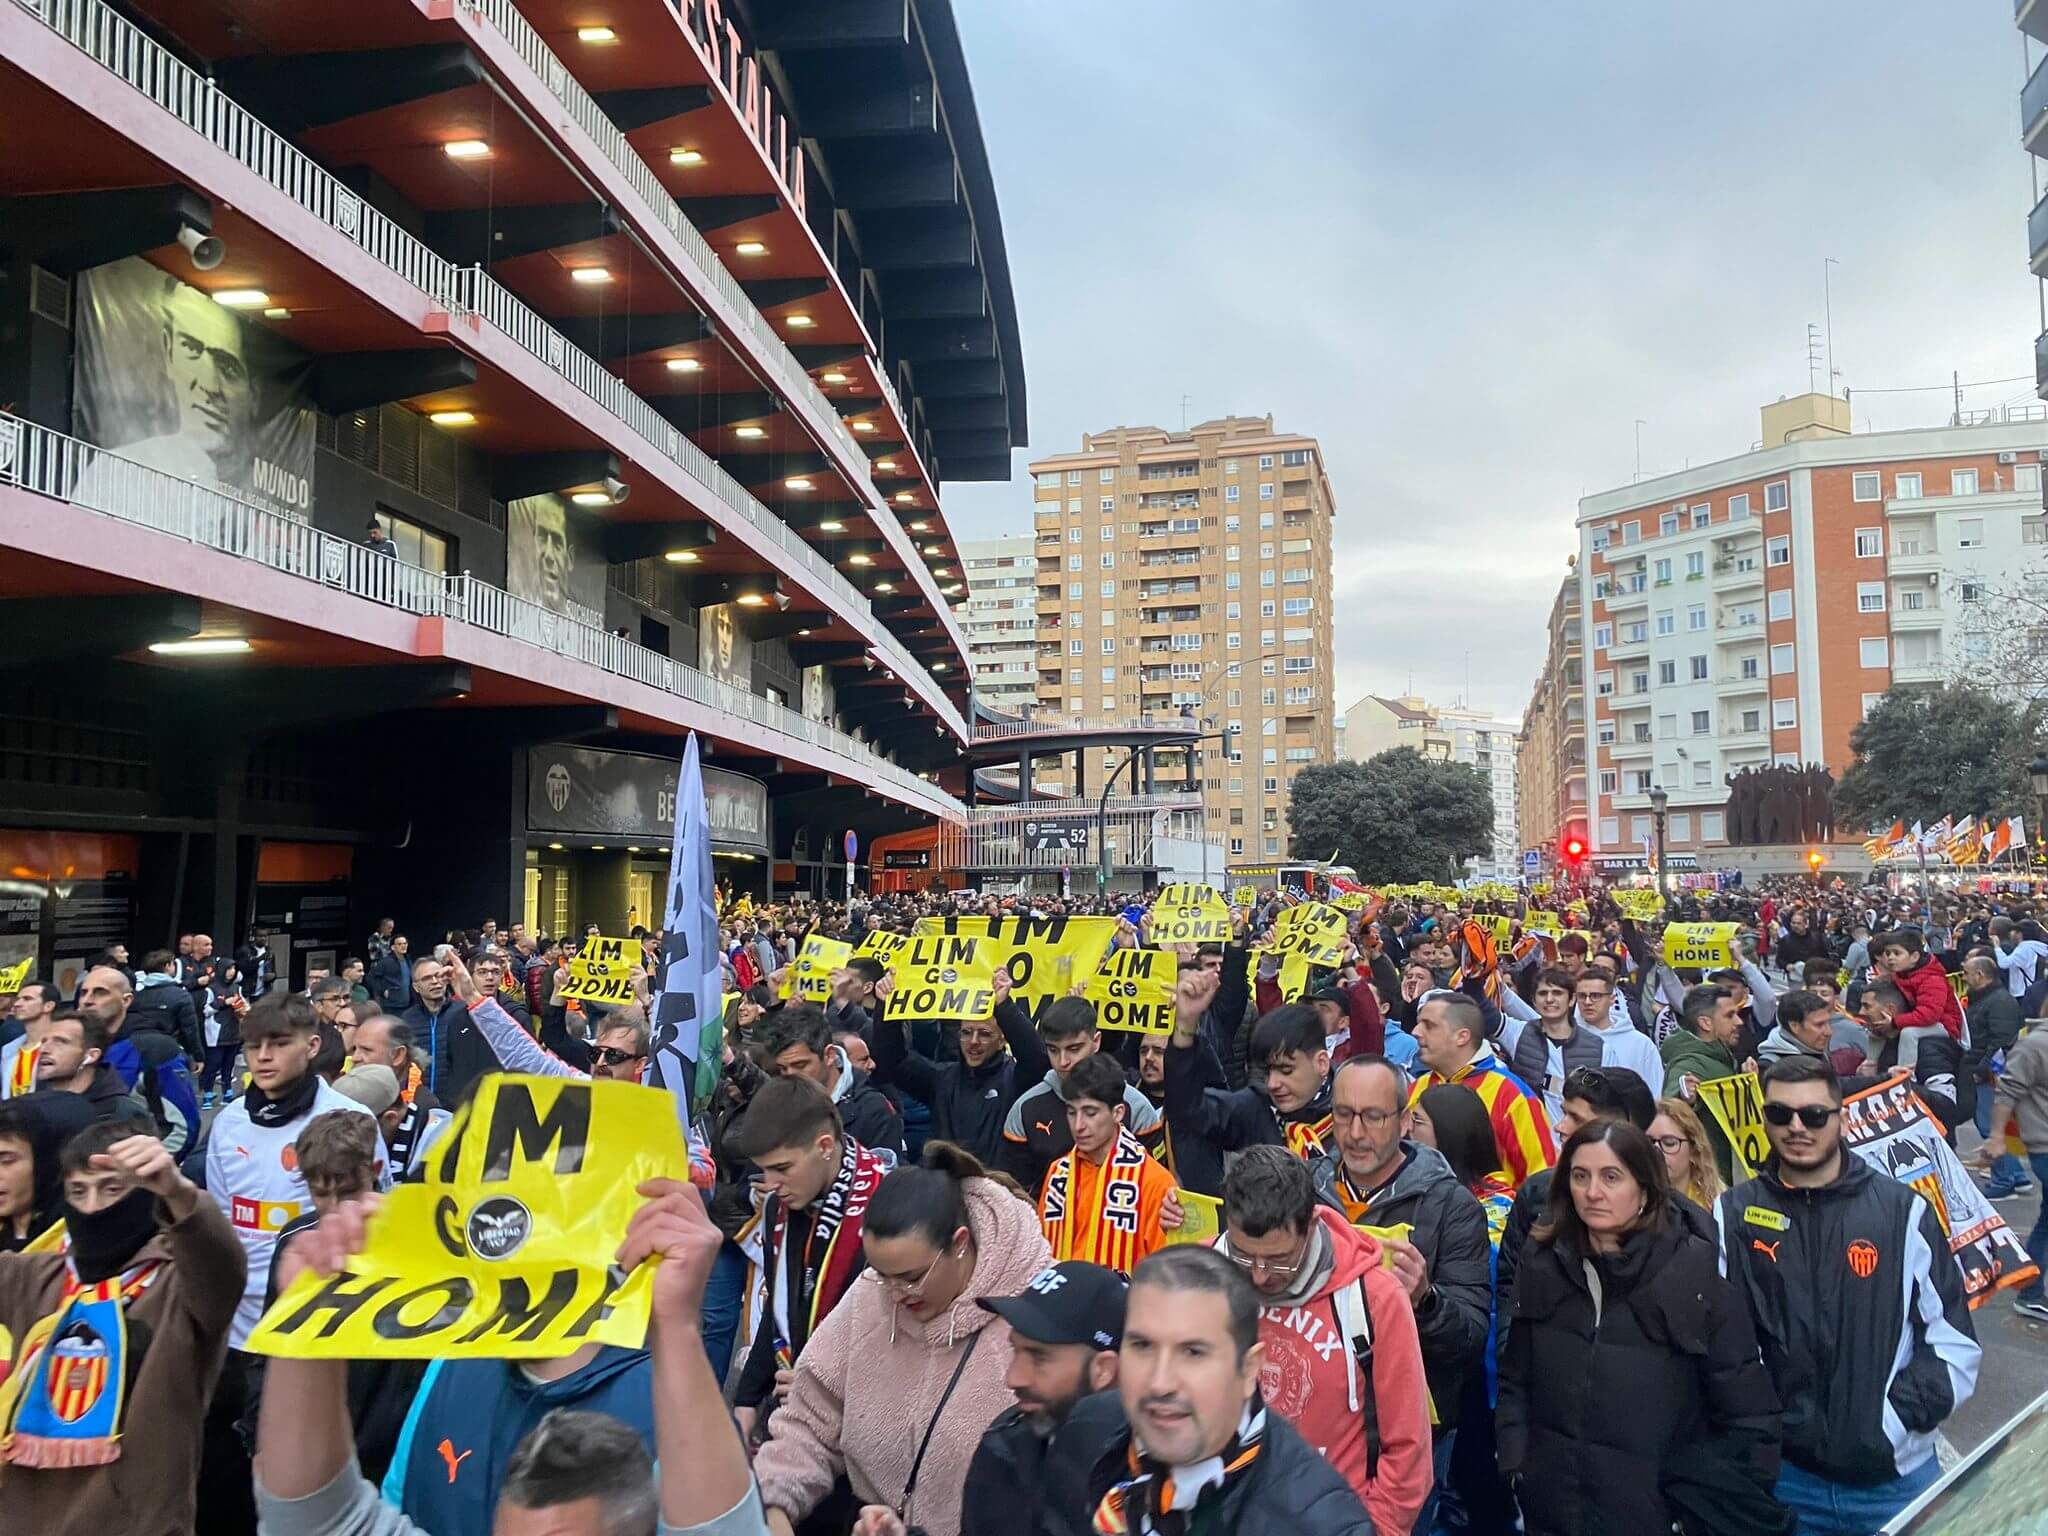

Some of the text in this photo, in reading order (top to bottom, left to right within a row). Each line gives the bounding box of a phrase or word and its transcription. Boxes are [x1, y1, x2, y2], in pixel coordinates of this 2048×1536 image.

[253, 457, 309, 509] MUNDO
[1070, 828, 1086, 843] 52
[1603, 860, 1624, 868] BAR
[1642, 859, 1696, 868] DRTIVA
[1165, 886, 1214, 905] LIM
[1177, 907, 1202, 918] GO
[1290, 905, 1339, 928] LIM
[1152, 921, 1229, 938] HOME
[578, 939, 623, 961] LIM
[866, 933, 906, 951] LIM
[1279, 933, 1340, 962] OME
[1687, 936, 1706, 946] GO
[910, 936, 979, 966] LIM
[1673, 948, 1721, 961] HOME
[587, 962, 609, 977] GO
[1096, 951, 1153, 979] LIM
[924, 967, 958, 984] GO
[561, 976, 635, 1000] HOME
[1108, 979, 1138, 998] GO
[887, 989, 995, 1015] HOME
[1716, 1077, 1763, 1131] LIM
[234, 1204, 255, 1223] TM
[1105, 1181, 1138, 1231] CF
[1746, 1210, 1760, 1219] LIM
